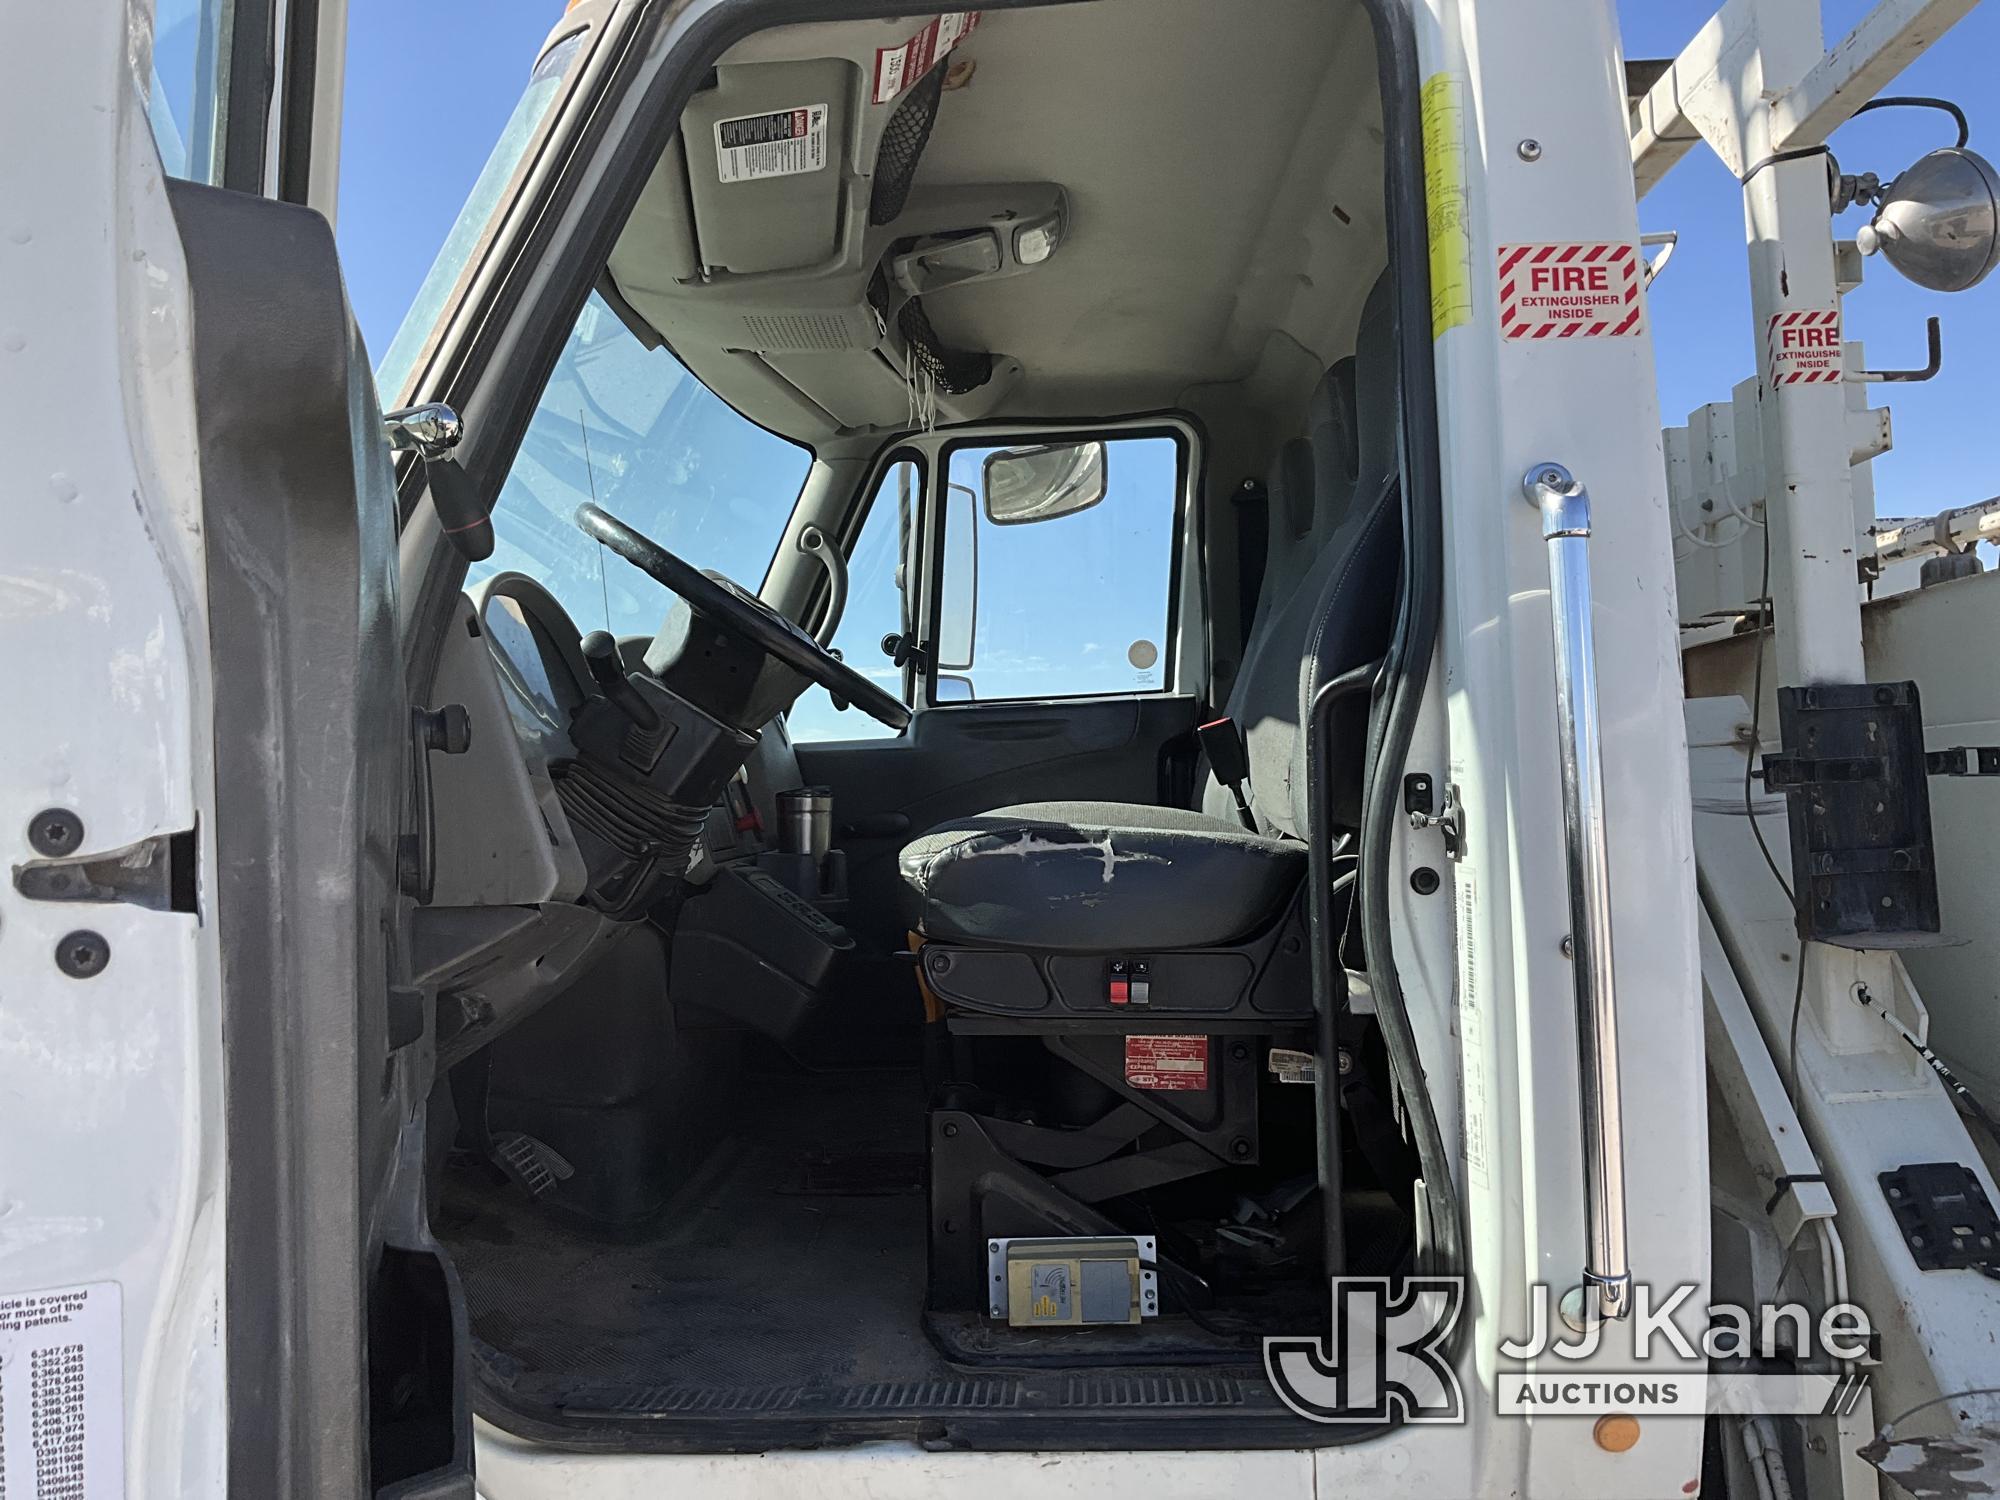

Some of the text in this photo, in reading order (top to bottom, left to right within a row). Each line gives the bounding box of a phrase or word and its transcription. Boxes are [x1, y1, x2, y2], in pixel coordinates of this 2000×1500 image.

[1531, 267, 1608, 291] FIRE
[1521, 295, 1619, 307] EXTINGUISHER
[1548, 309, 1593, 319] INSIDE
[1782, 327, 1839, 348] FIRE
[1797, 360, 1829, 368] INSIDE
[26, 1296, 36, 1307] is
[39, 1290, 88, 1305] covered
[15, 1307, 46, 1319] more
[50, 1304, 61, 1314] of
[65, 1302, 84, 1311] the
[25, 1315, 72, 1329] patents.
[37, 1463, 83, 1477] D401198
